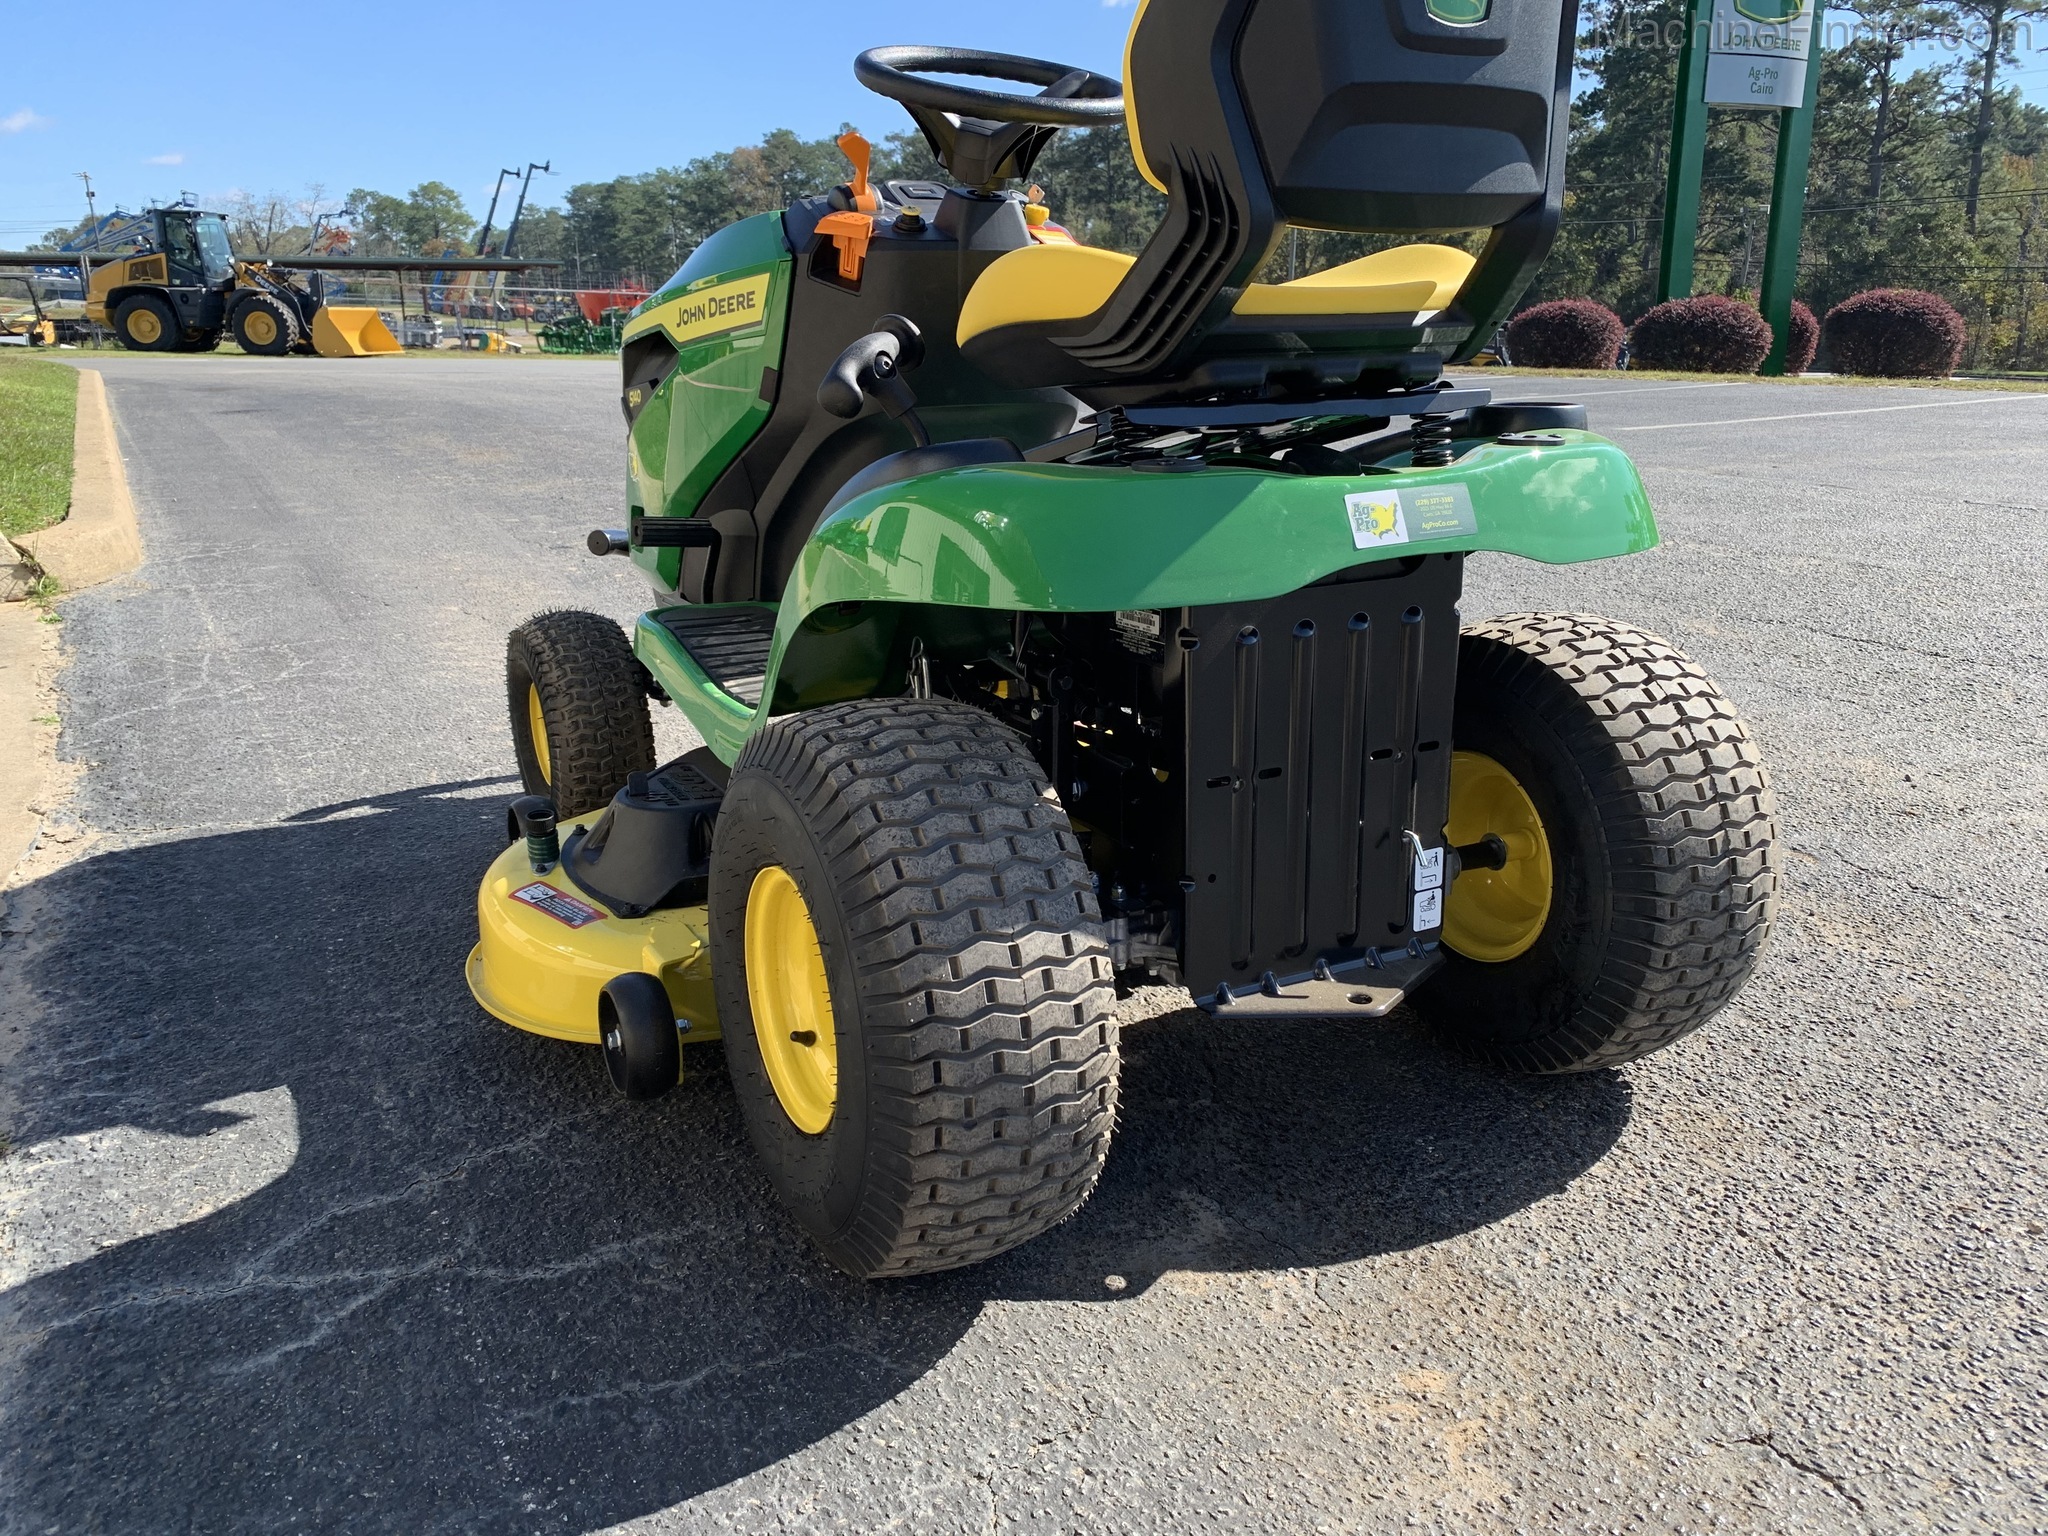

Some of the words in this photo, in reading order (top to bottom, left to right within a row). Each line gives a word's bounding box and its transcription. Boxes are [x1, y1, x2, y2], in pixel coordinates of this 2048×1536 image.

[1722, 32, 1761, 48] JOHN
[1763, 34, 1801, 51] DEERE
[1747, 66, 1779, 81] Ag-Pro
[1750, 82, 1774, 95] Cairo
[255, 275, 279, 295] DEERE
[676, 303, 706, 328] JOHN
[708, 290, 756, 319] DEERE
[1354, 517, 1379, 533] Pro
[1421, 520, 1459, 531] AgProCo.com
